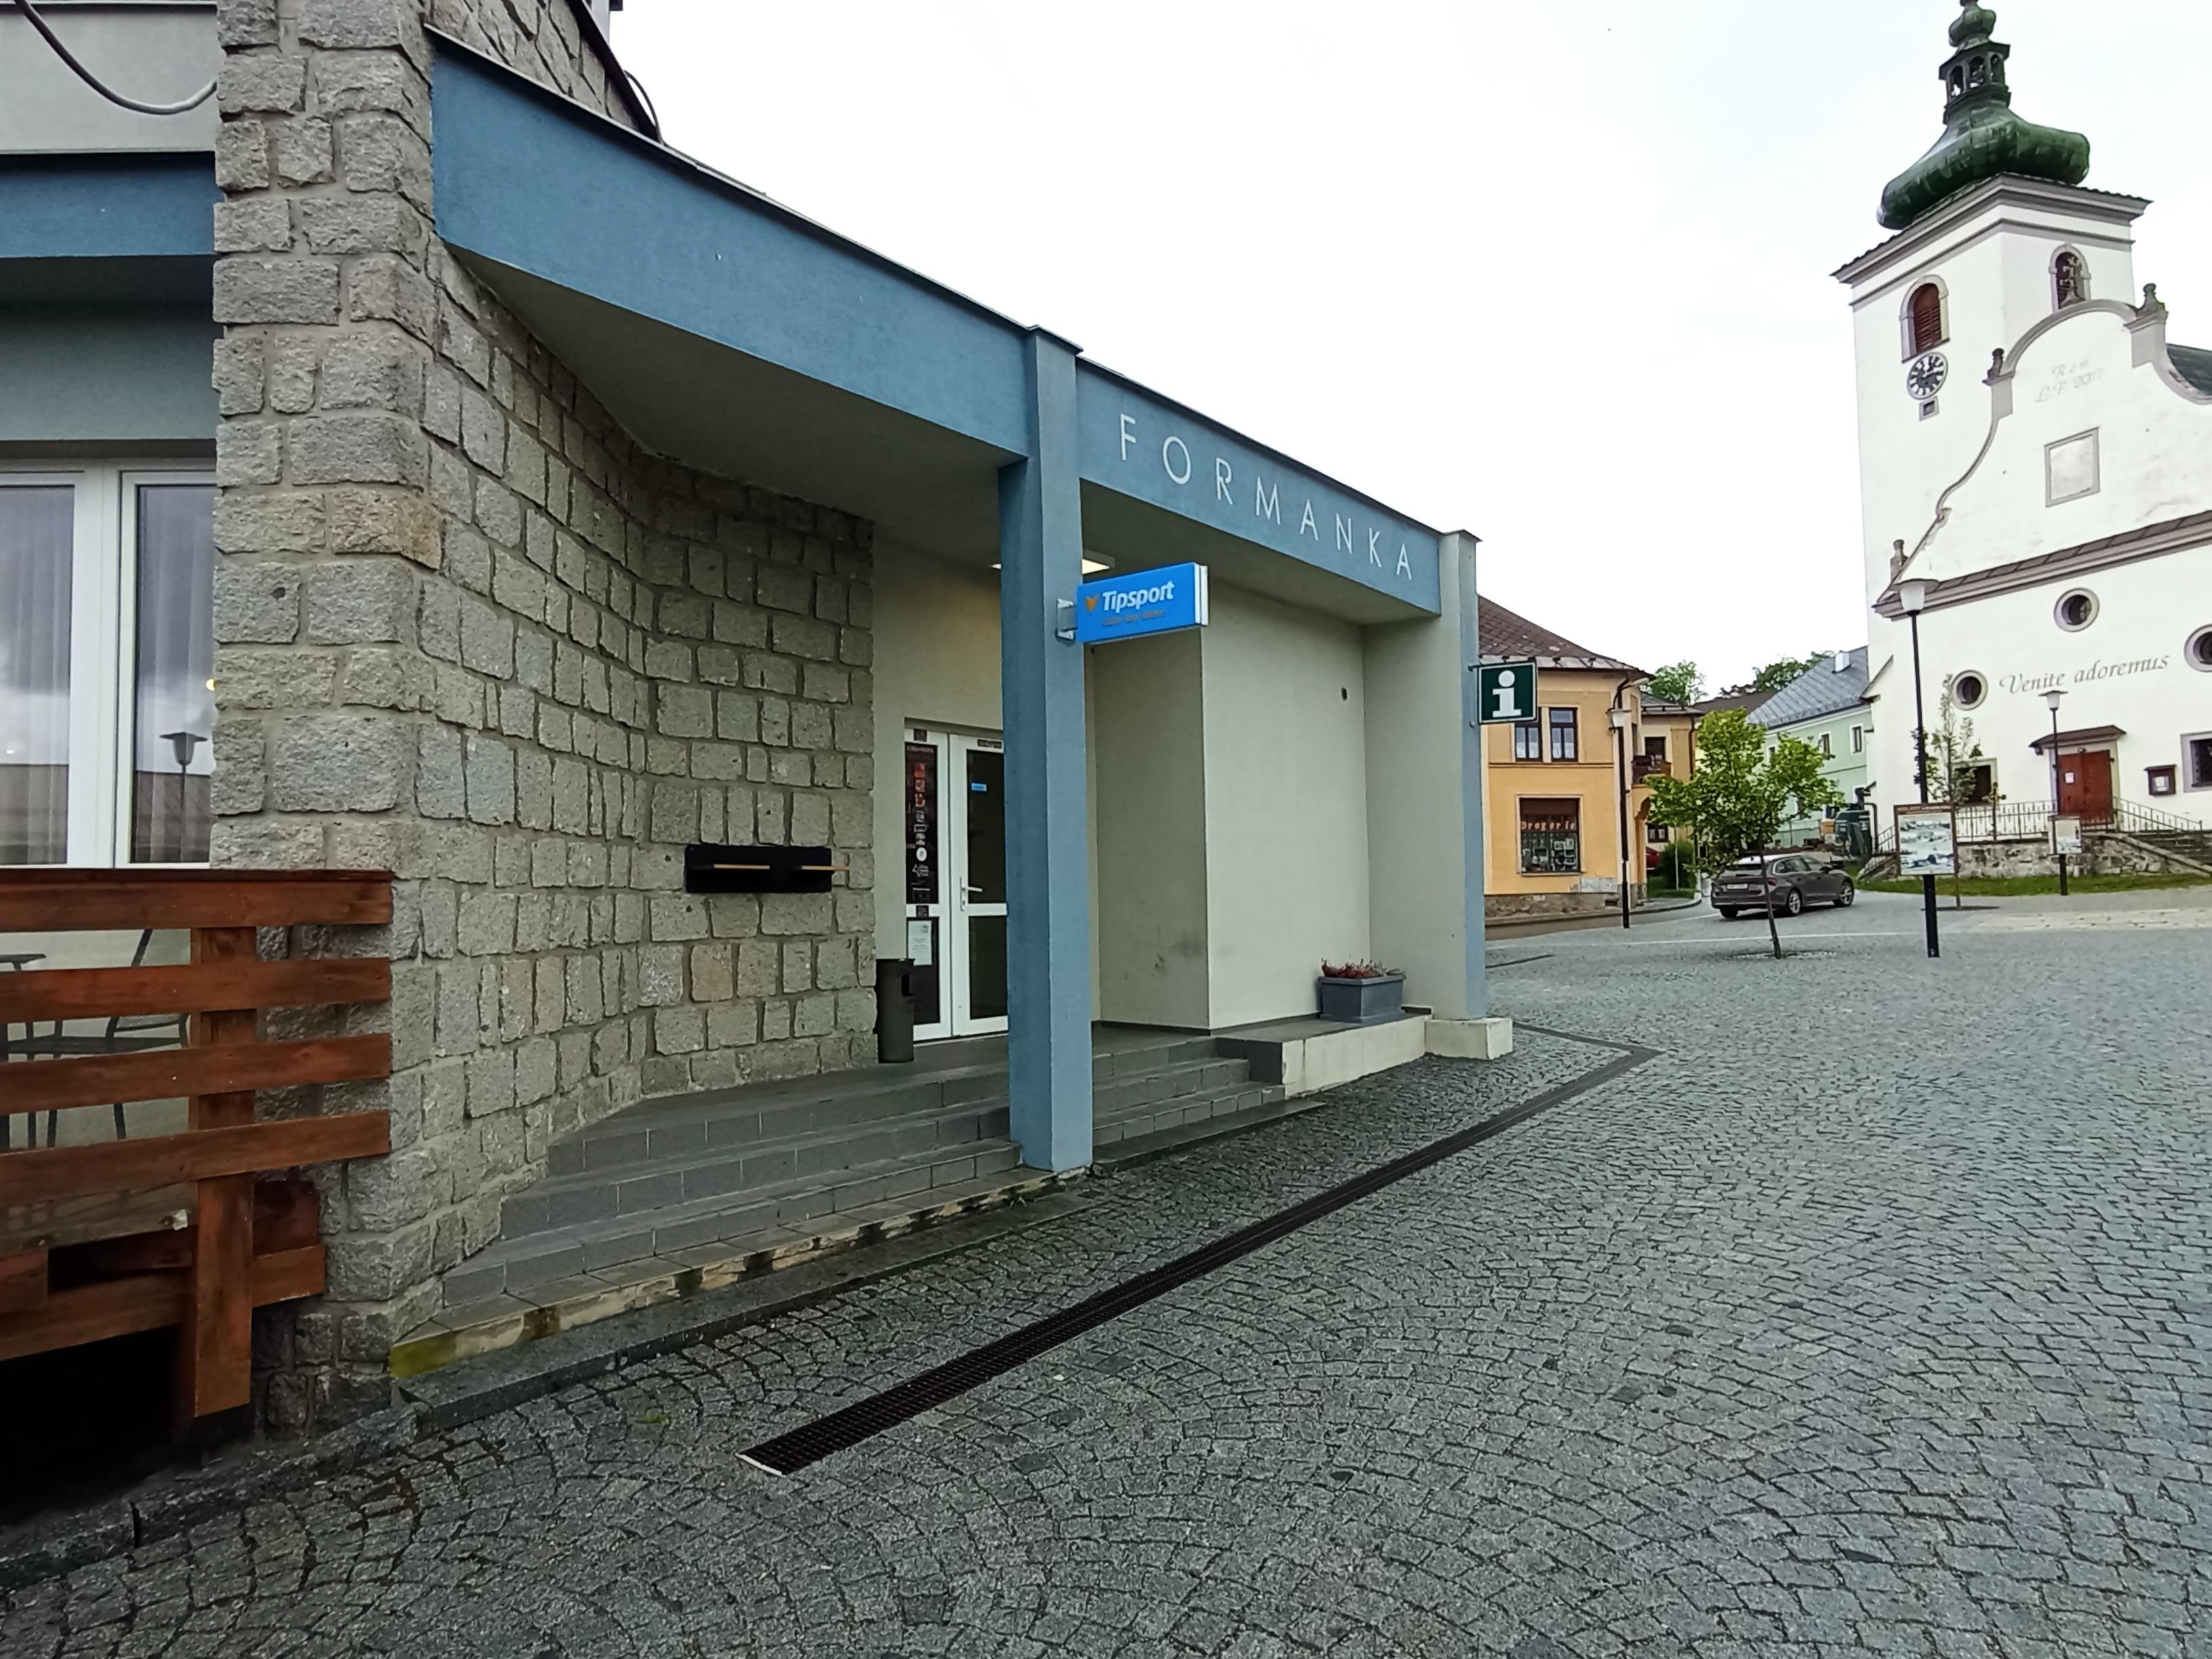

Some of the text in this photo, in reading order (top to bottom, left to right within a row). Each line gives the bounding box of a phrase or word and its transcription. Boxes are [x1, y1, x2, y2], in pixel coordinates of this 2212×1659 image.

[1119, 413, 1412, 581] FORMANKA
[1102, 580, 1174, 613] Tipsport
[1999, 655, 2170, 694] Venite adoremus
